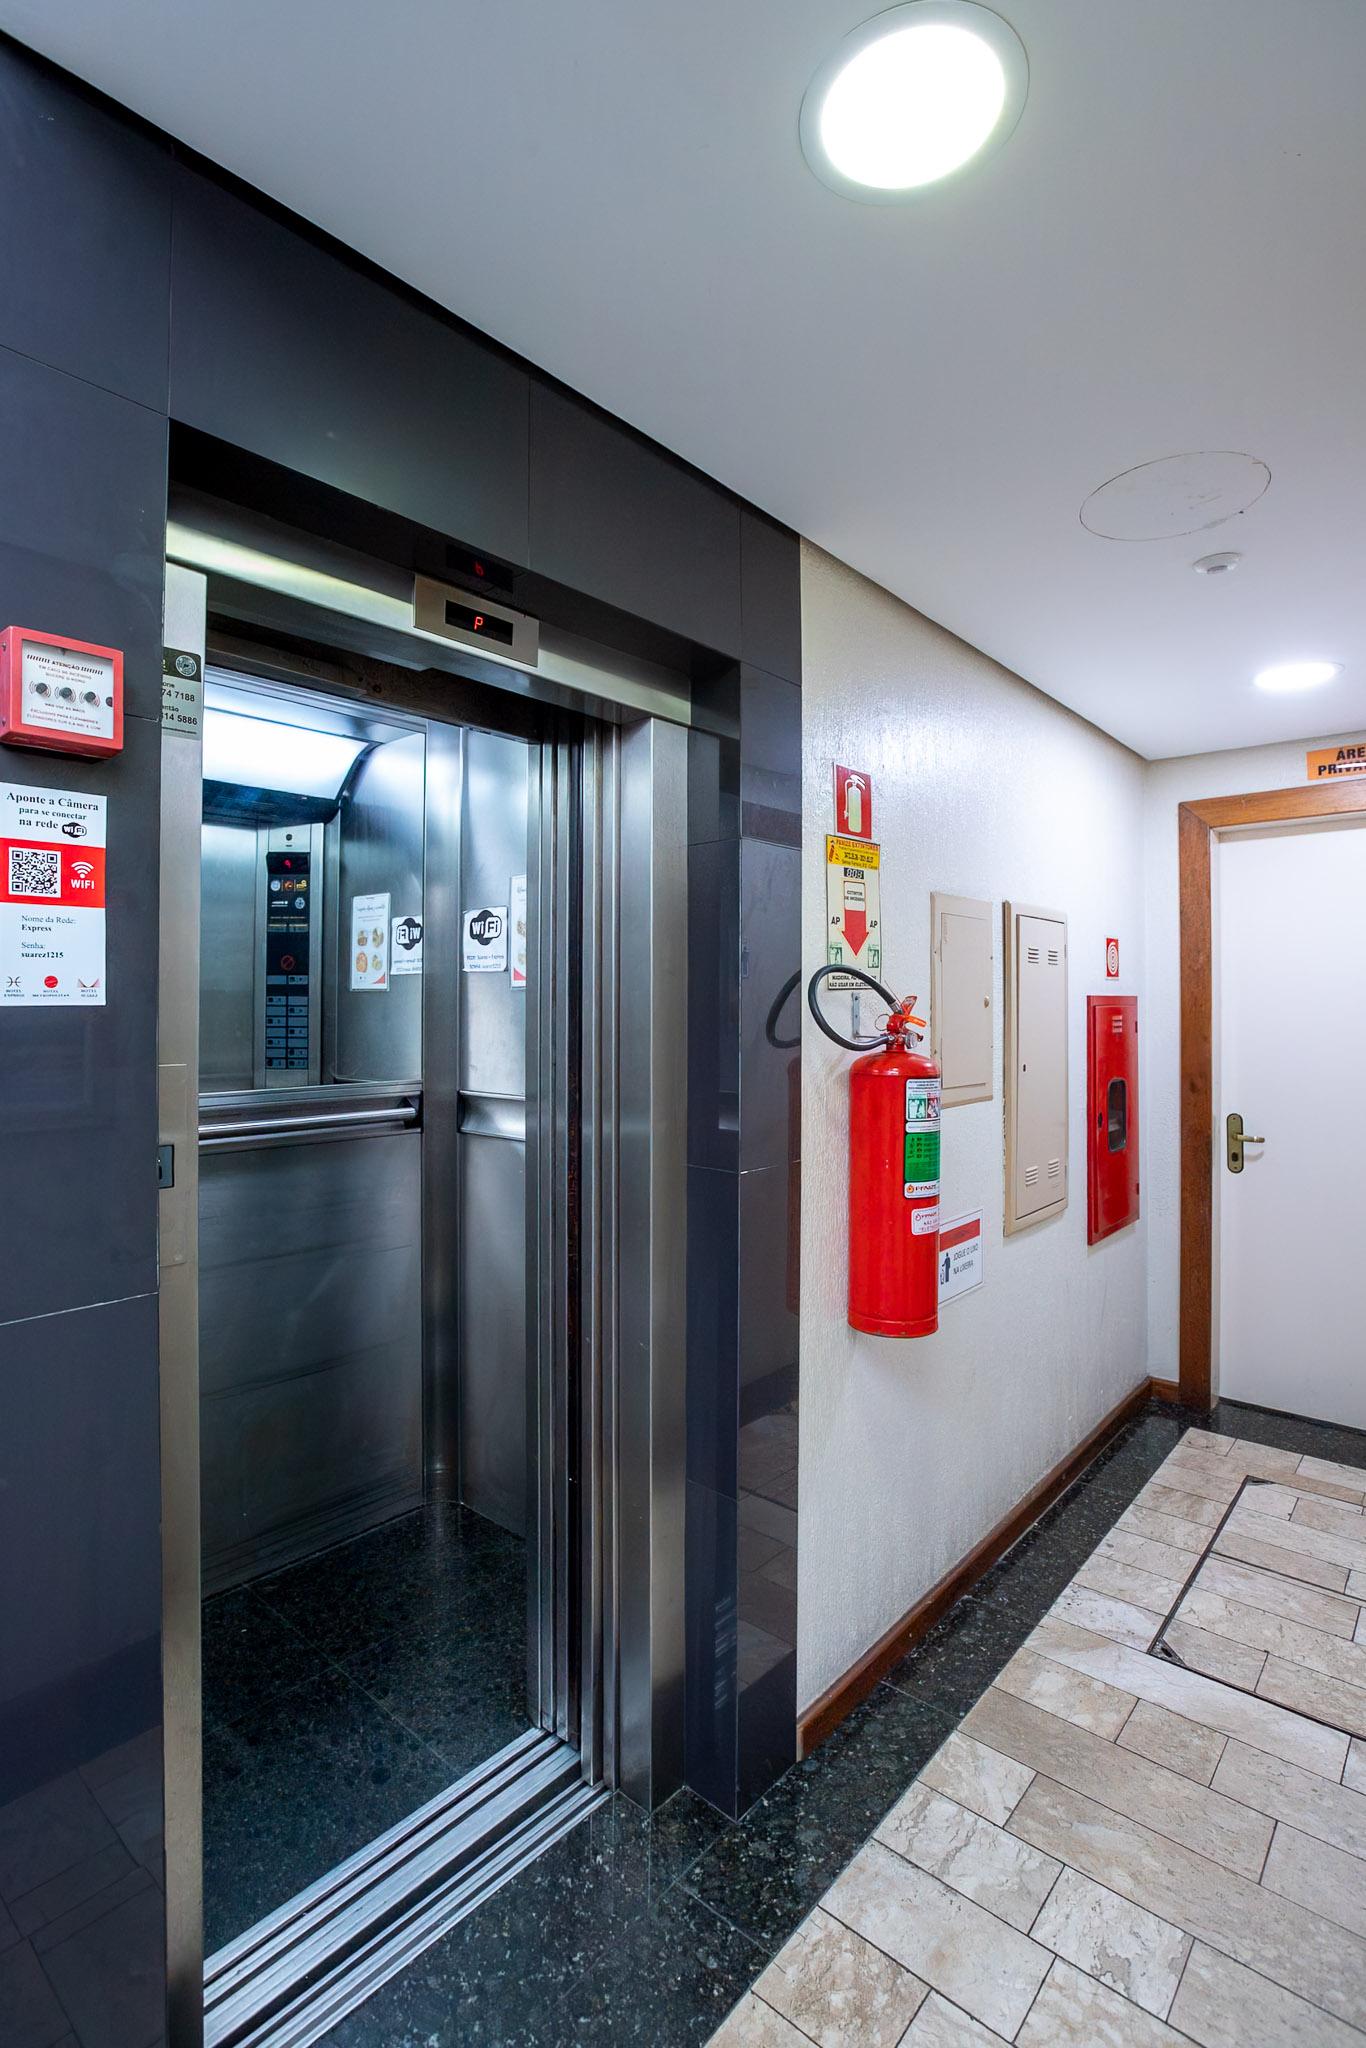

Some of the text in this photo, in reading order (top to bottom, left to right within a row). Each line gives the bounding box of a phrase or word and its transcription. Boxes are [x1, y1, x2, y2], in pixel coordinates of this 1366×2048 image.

[474, 616, 484, 631] P
[52, 660, 80, 671] ATENÇÃO
[175, 690, 196, 702] 7188
[178, 714, 198, 726] 5886
[6, 792, 99, 811] Aponte a Câmera
[19, 807, 39, 815] para
[52, 811, 87, 821] conectar
[19, 818, 32, 827] na
[35, 820, 59, 830] rede
[71, 879, 95, 889] WIFI
[22, 915, 44, 923] Nome
[56, 917, 77, 925] Rede:
[831, 916, 841, 925] AP
[870, 920, 878, 928] AP
[21, 924, 52, 933] Express
[471, 920, 499, 935] WiFi
[21, 941, 46, 949] Senha:
[21, 951, 64, 959] suarez1215
